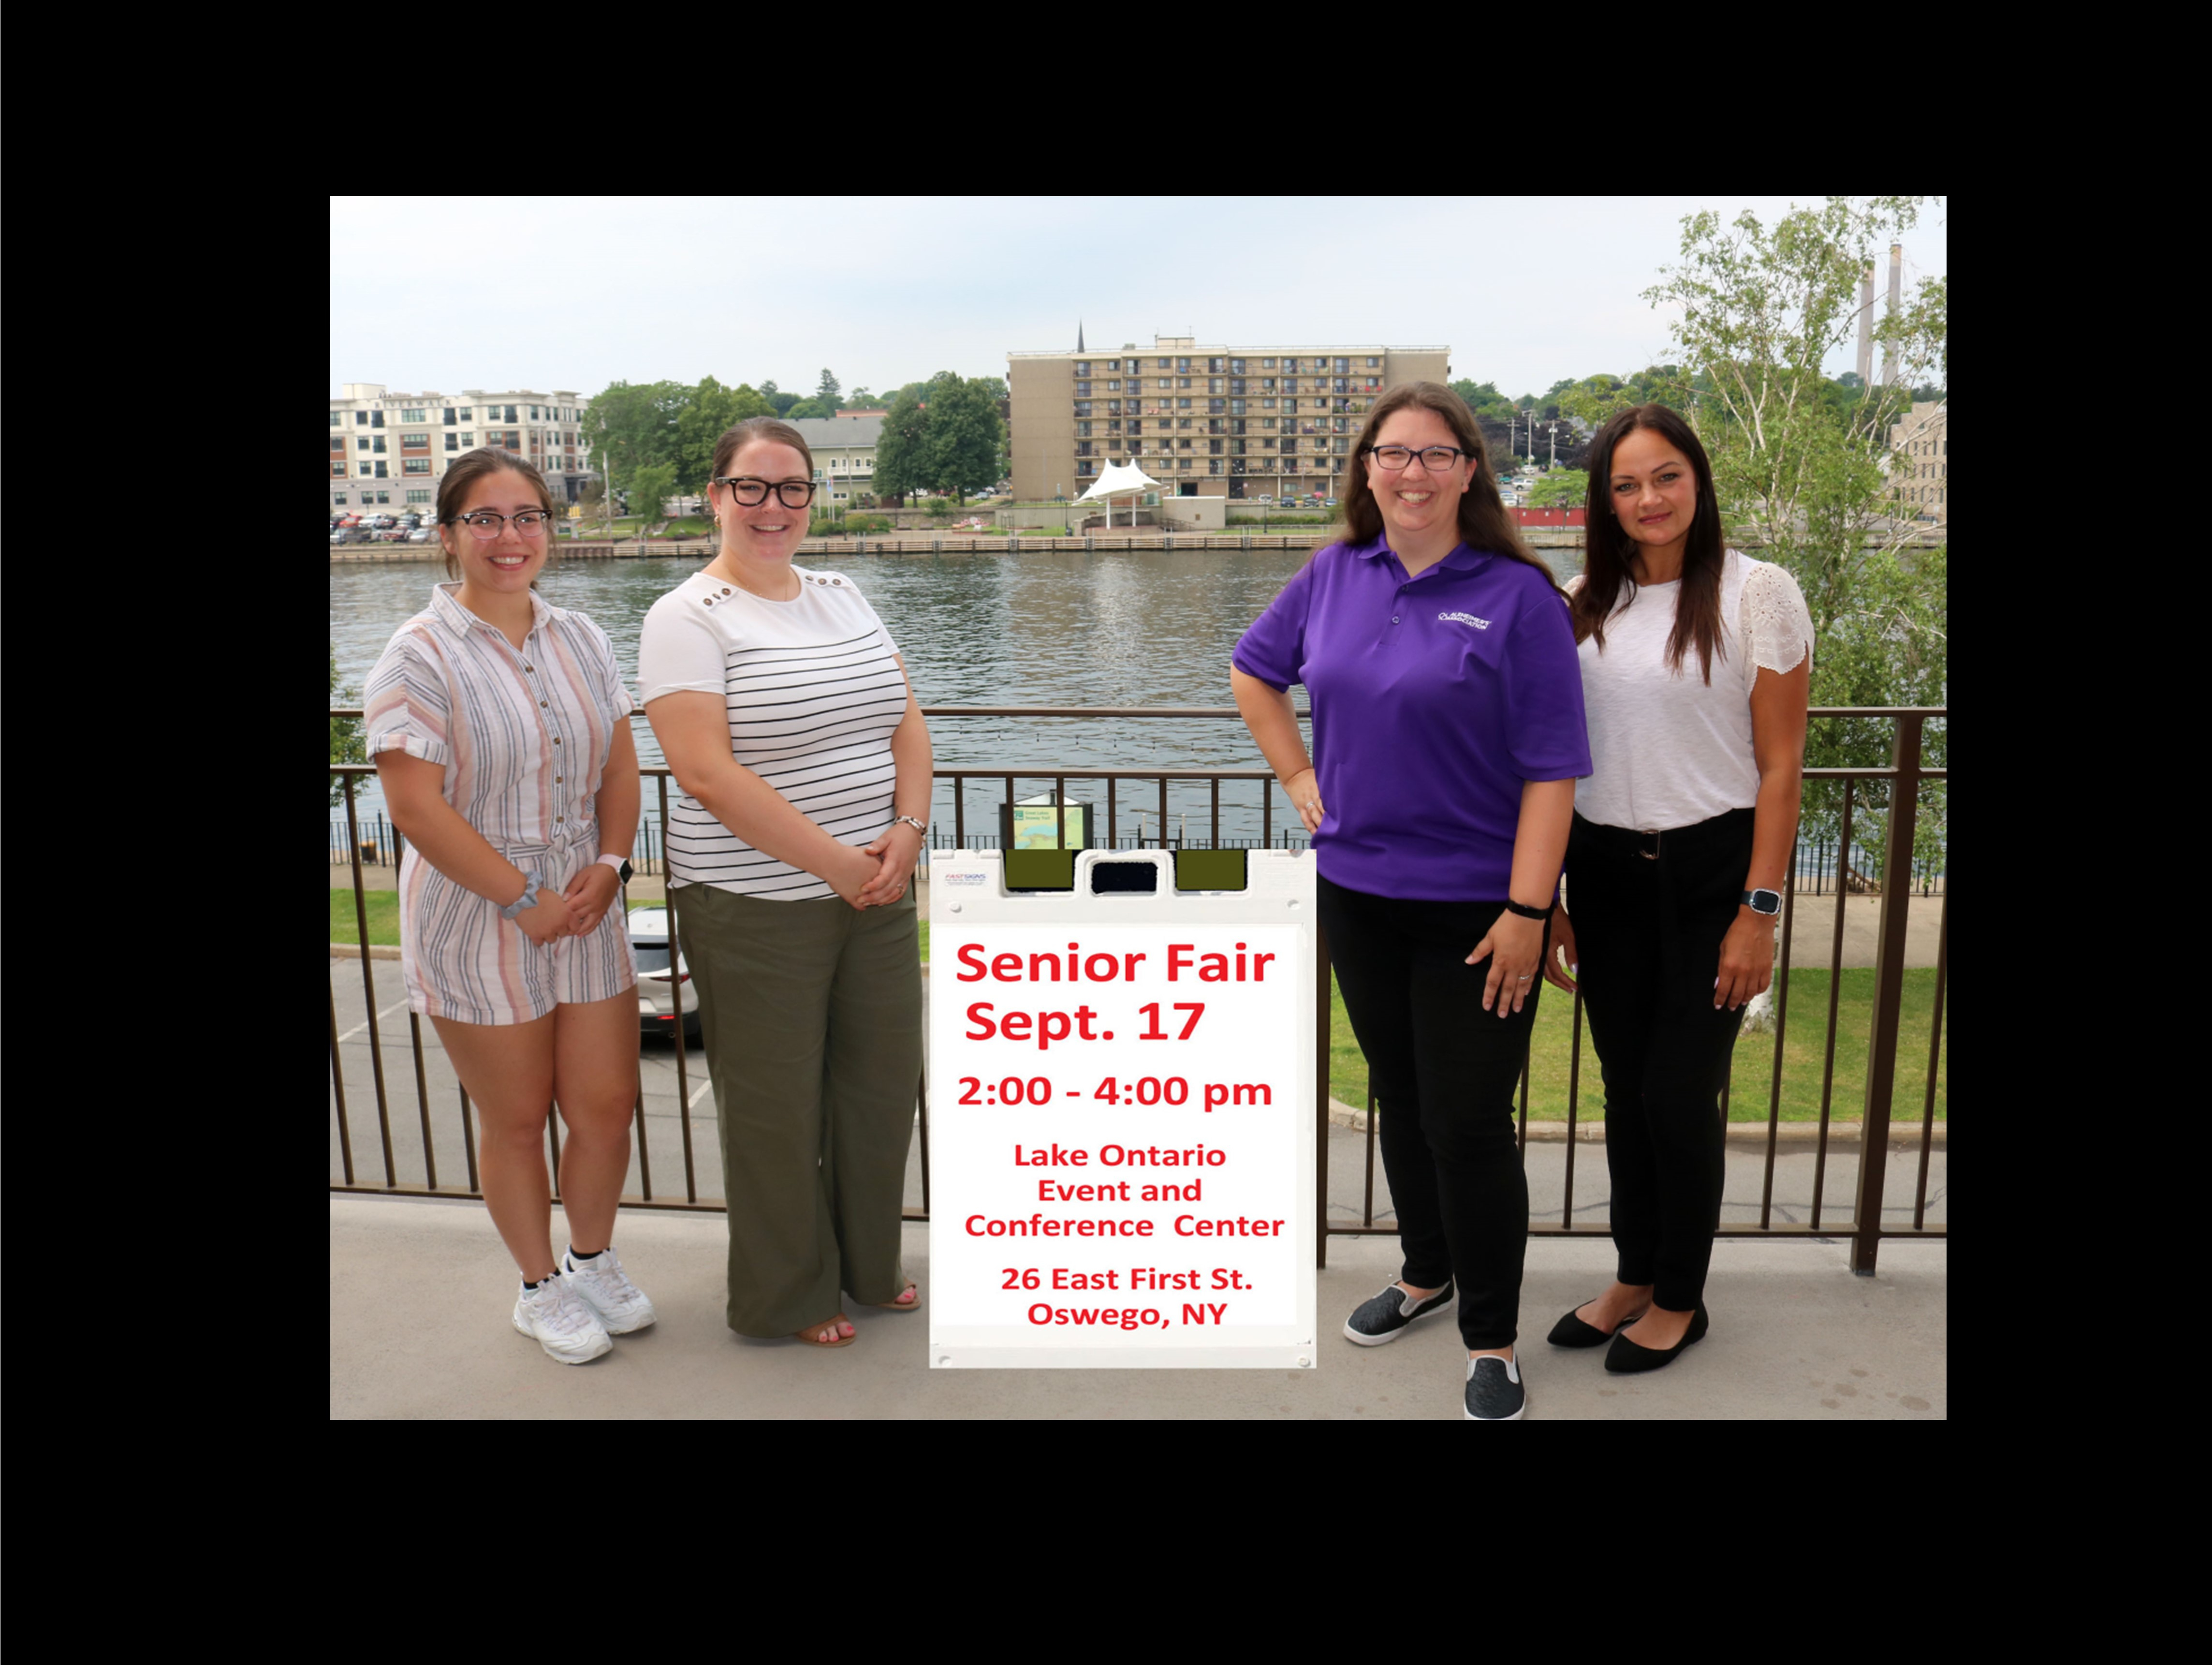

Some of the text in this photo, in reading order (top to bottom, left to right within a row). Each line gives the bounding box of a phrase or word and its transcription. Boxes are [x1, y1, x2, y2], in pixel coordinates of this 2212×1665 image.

[375, 399, 451, 409] RIVERWALK
[956, 942, 1275, 982] Senior Fair
[966, 1002, 1204, 1050] Sept. 17
[958, 1076, 1051, 1105] 2:00
[1094, 1076, 1188, 1105] 4:00
[1204, 1083, 1271, 1112] pm
[1015, 1143, 1226, 1166] Lake Ontario
[1039, 1179, 1201, 1201] Event and
[965, 1213, 1284, 1237] Conference Center
[1002, 1267, 1253, 1290] 26 East First St.
[1027, 1303, 1227, 1330] Oswego, NY
